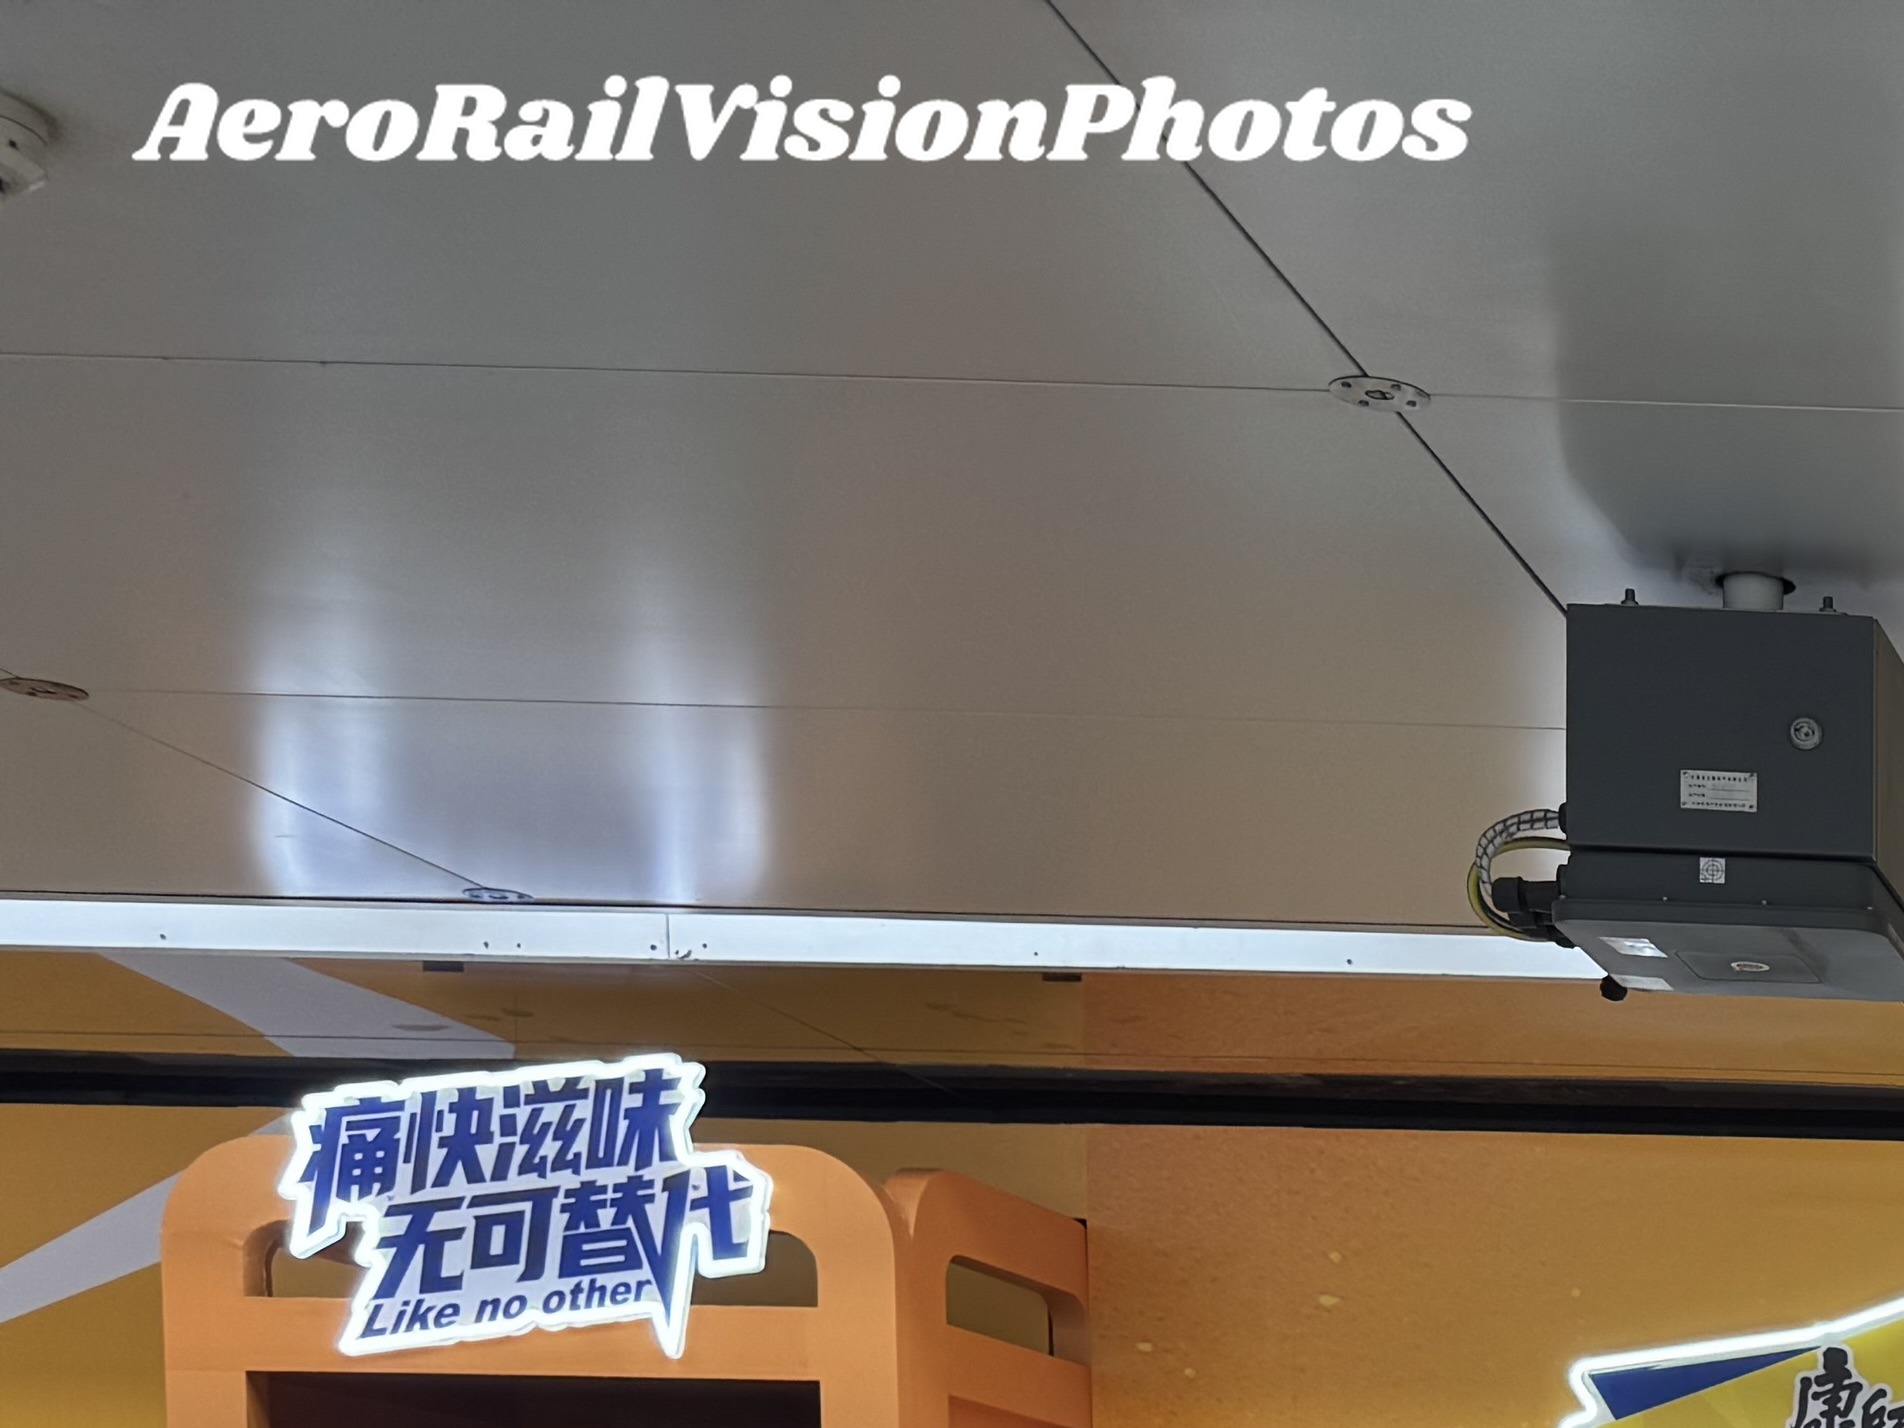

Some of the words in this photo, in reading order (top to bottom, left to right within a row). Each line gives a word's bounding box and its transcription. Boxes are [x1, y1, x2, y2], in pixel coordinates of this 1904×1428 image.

[300, 1068, 680, 1236] 痛快滋味
[359, 1298, 461, 1339] Like
[474, 1294, 527, 1323] no
[542, 1277, 653, 1315] other
[372, 1165, 753, 1329] 无可替代
